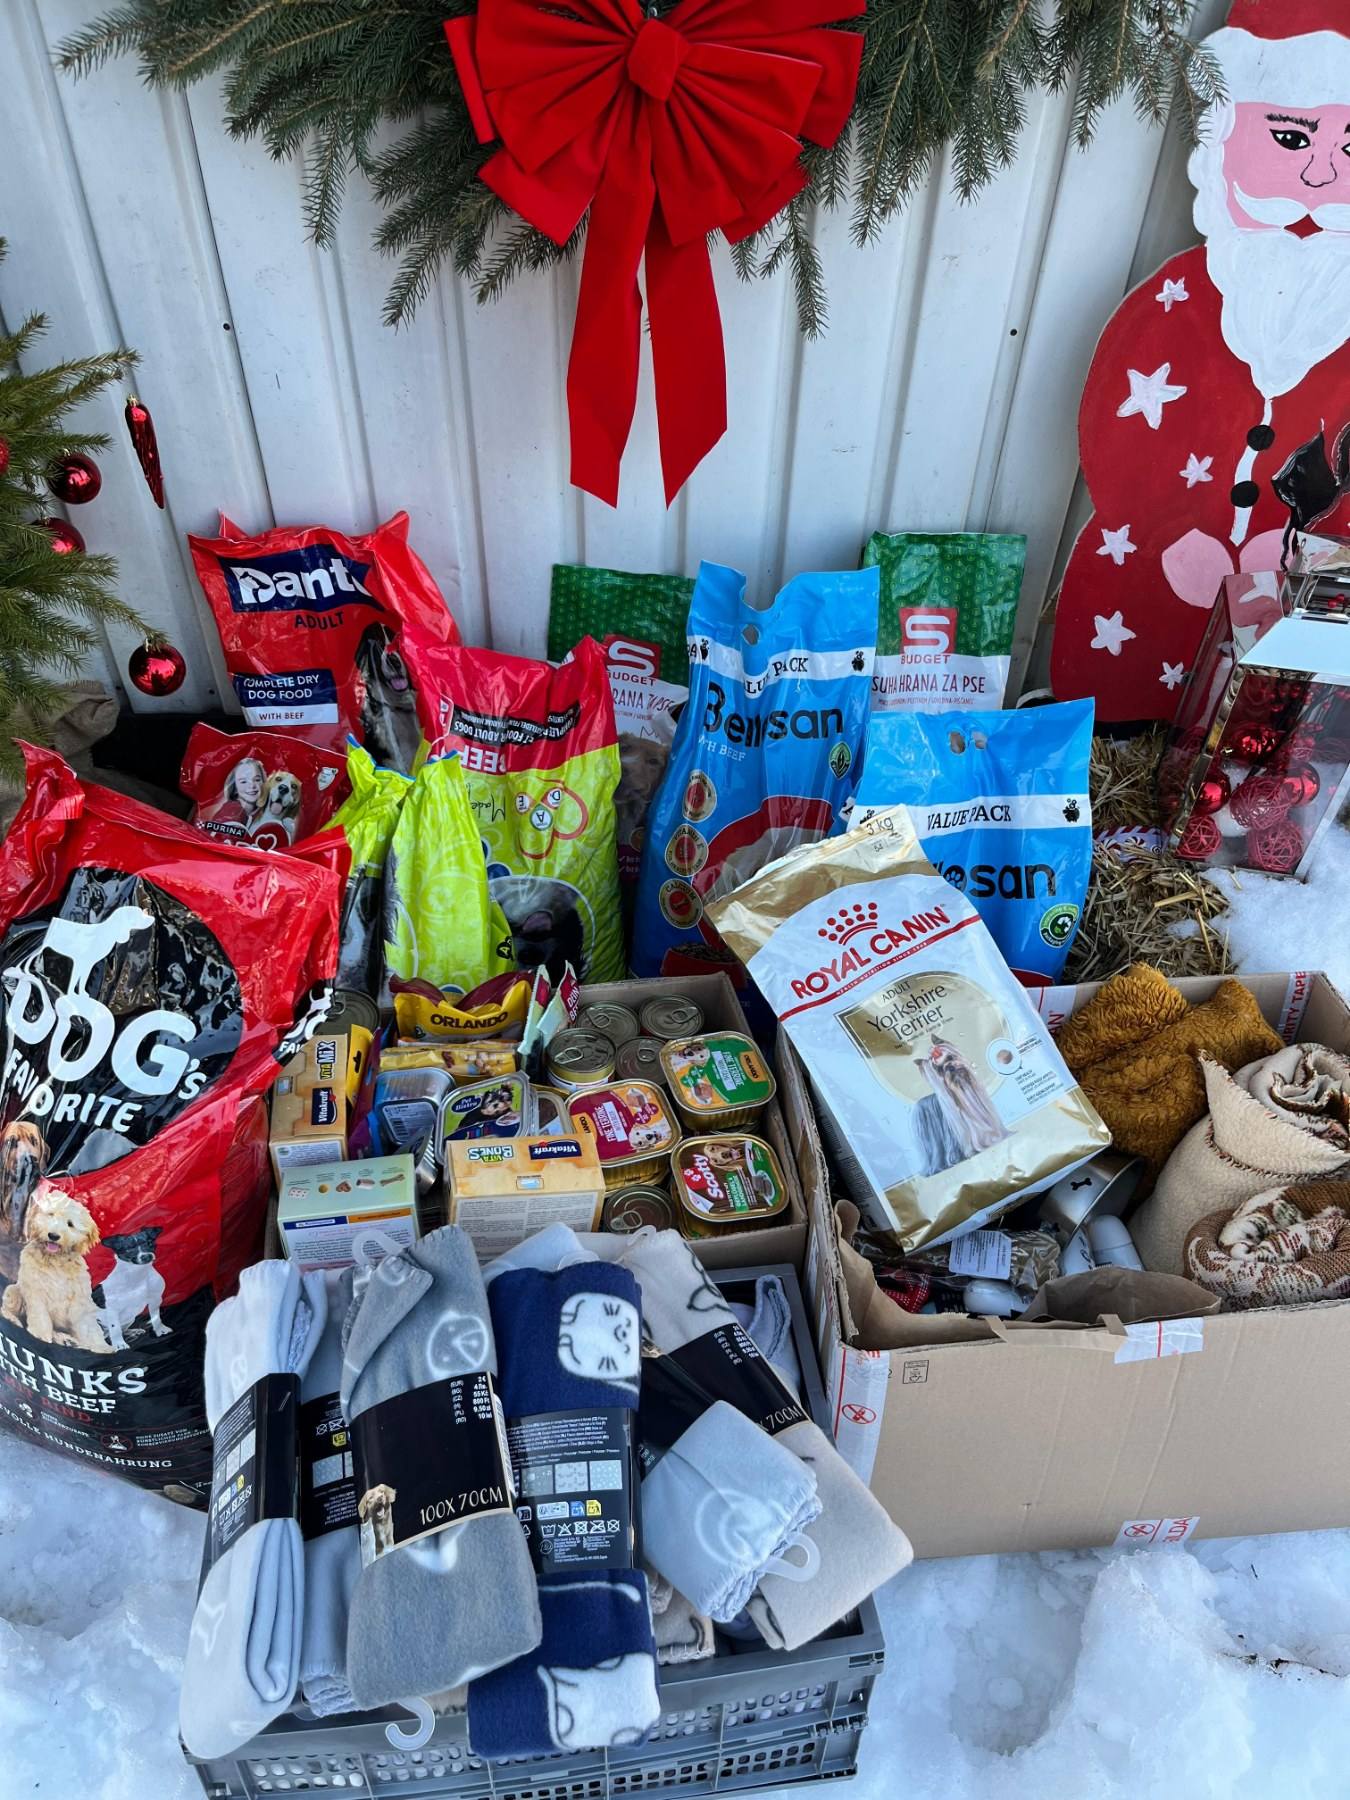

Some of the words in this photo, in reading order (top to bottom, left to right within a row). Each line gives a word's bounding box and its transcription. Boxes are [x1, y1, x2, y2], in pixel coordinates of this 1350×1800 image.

[294, 611, 344, 630] ADULT
[900, 654, 952, 665] BUDGET
[297, 674, 320, 685] DRY
[898, 673, 938, 693] HRANA
[941, 674, 958, 692] ZA
[962, 676, 986, 694] PSE
[248, 689, 276, 700] DOG
[279, 688, 313, 699] FOOD
[613, 687, 644, 710] RANA
[259, 711, 282, 721] WITH
[284, 711, 305, 720] BEEF
[453, 719, 473, 737] DOGS
[477, 726, 500, 743] ADULT
[718, 743, 747, 763] BEEF
[205, 821, 244, 837] PURINA
[866, 822, 875, 836] 3
[875, 816, 894, 832] kg
[926, 810, 972, 832] VALUE
[970, 803, 1013, 825] PACK
[790, 946, 872, 1000] ROYAL
[869, 905, 951, 956] CANIN
[881, 980, 912, 1004] ADULT
[1291, 970, 1307, 1004] TAPE
[866, 983, 948, 1033] Yorkshire
[430, 1011, 508, 1029] ORLANDO
[888, 1004, 944, 1041] Terrier
[4, 1048, 143, 1133] FAVORITE
[318, 1089, 329, 1123] Vitakraft
[534, 1145, 578, 1155] Vitakraft
[692, 1154, 725, 1199] Scotty
[45, 1383, 116, 1415] BEEF
[765, 1404, 803, 1430] 70CM
[43, 1431, 174, 1469] HUNDENAHRUNG
[419, 1497, 456, 1526] 100X
[458, 1485, 504, 1512] 70CM
